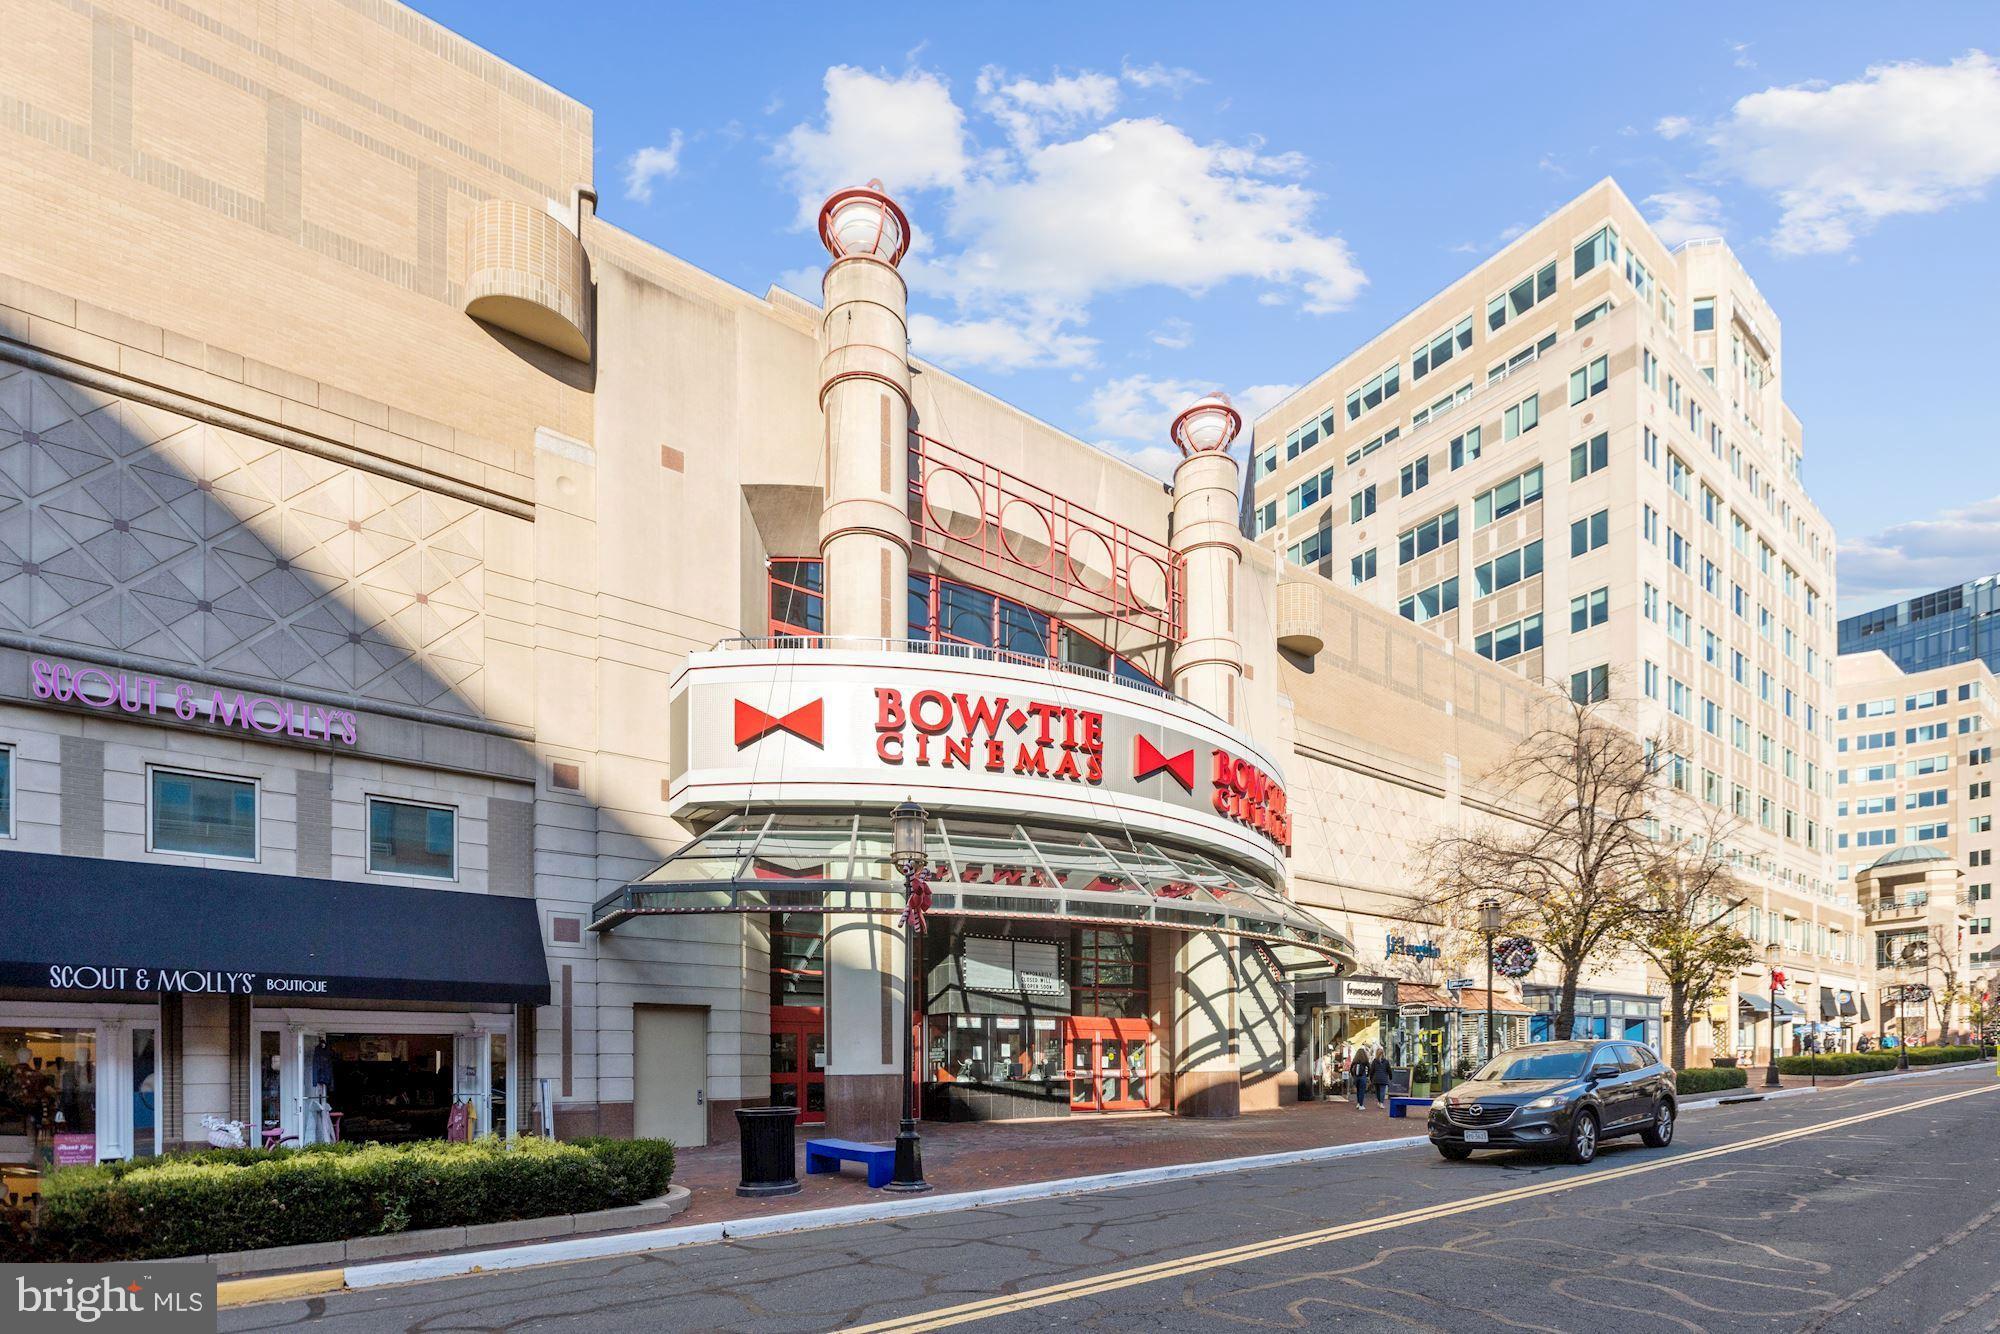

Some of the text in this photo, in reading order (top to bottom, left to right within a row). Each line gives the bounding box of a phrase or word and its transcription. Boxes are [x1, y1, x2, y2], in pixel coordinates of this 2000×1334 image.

[32, 659, 357, 745] SCOUT & MOLLY'S
[876, 731, 1104, 786] CINEMAS
[1212, 788, 1292, 848] CINE
[50, 964, 328, 994] SCOUT & MOLLY'S BOUTIQUE
